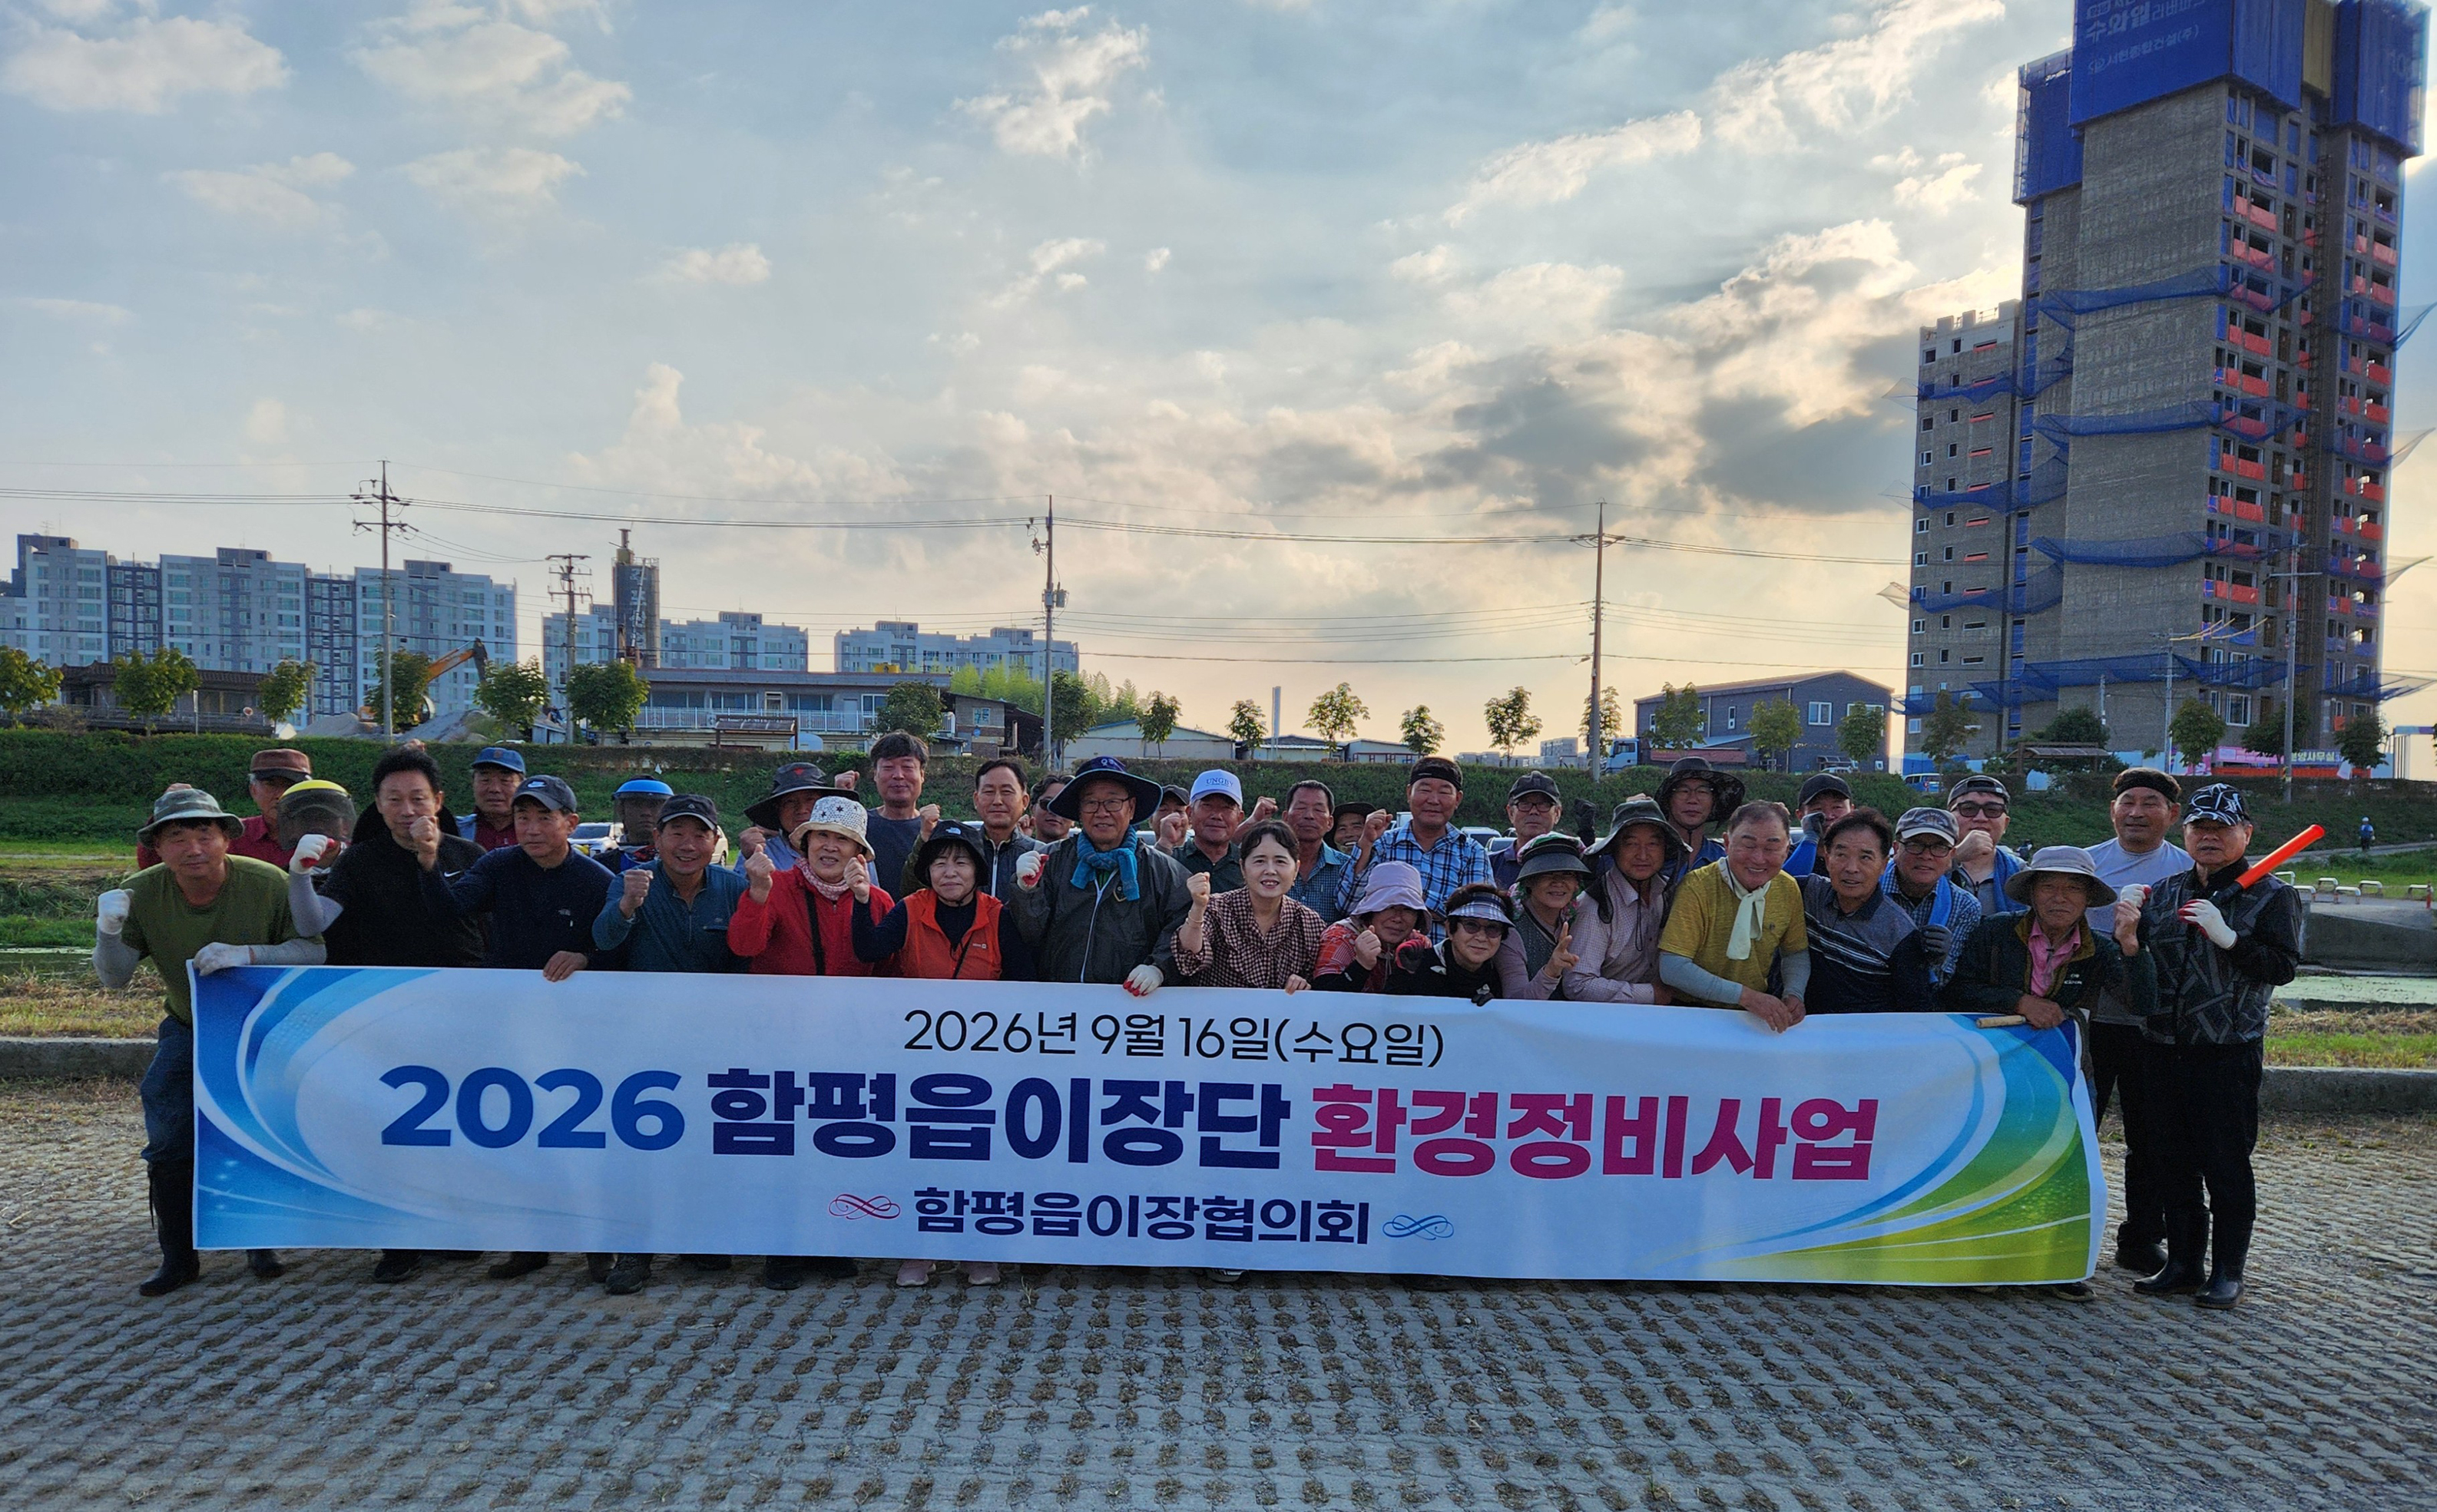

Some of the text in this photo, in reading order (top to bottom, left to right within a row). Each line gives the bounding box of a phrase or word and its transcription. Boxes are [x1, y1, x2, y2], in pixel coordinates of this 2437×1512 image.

[904, 1009, 1444, 1068] 2026년 9월 16일(수요일)
[379, 1064, 1879, 1181] 2026 함평읍이장단 환경정비사업
[914, 1186, 1369, 1245] 함평읍이장협의회
